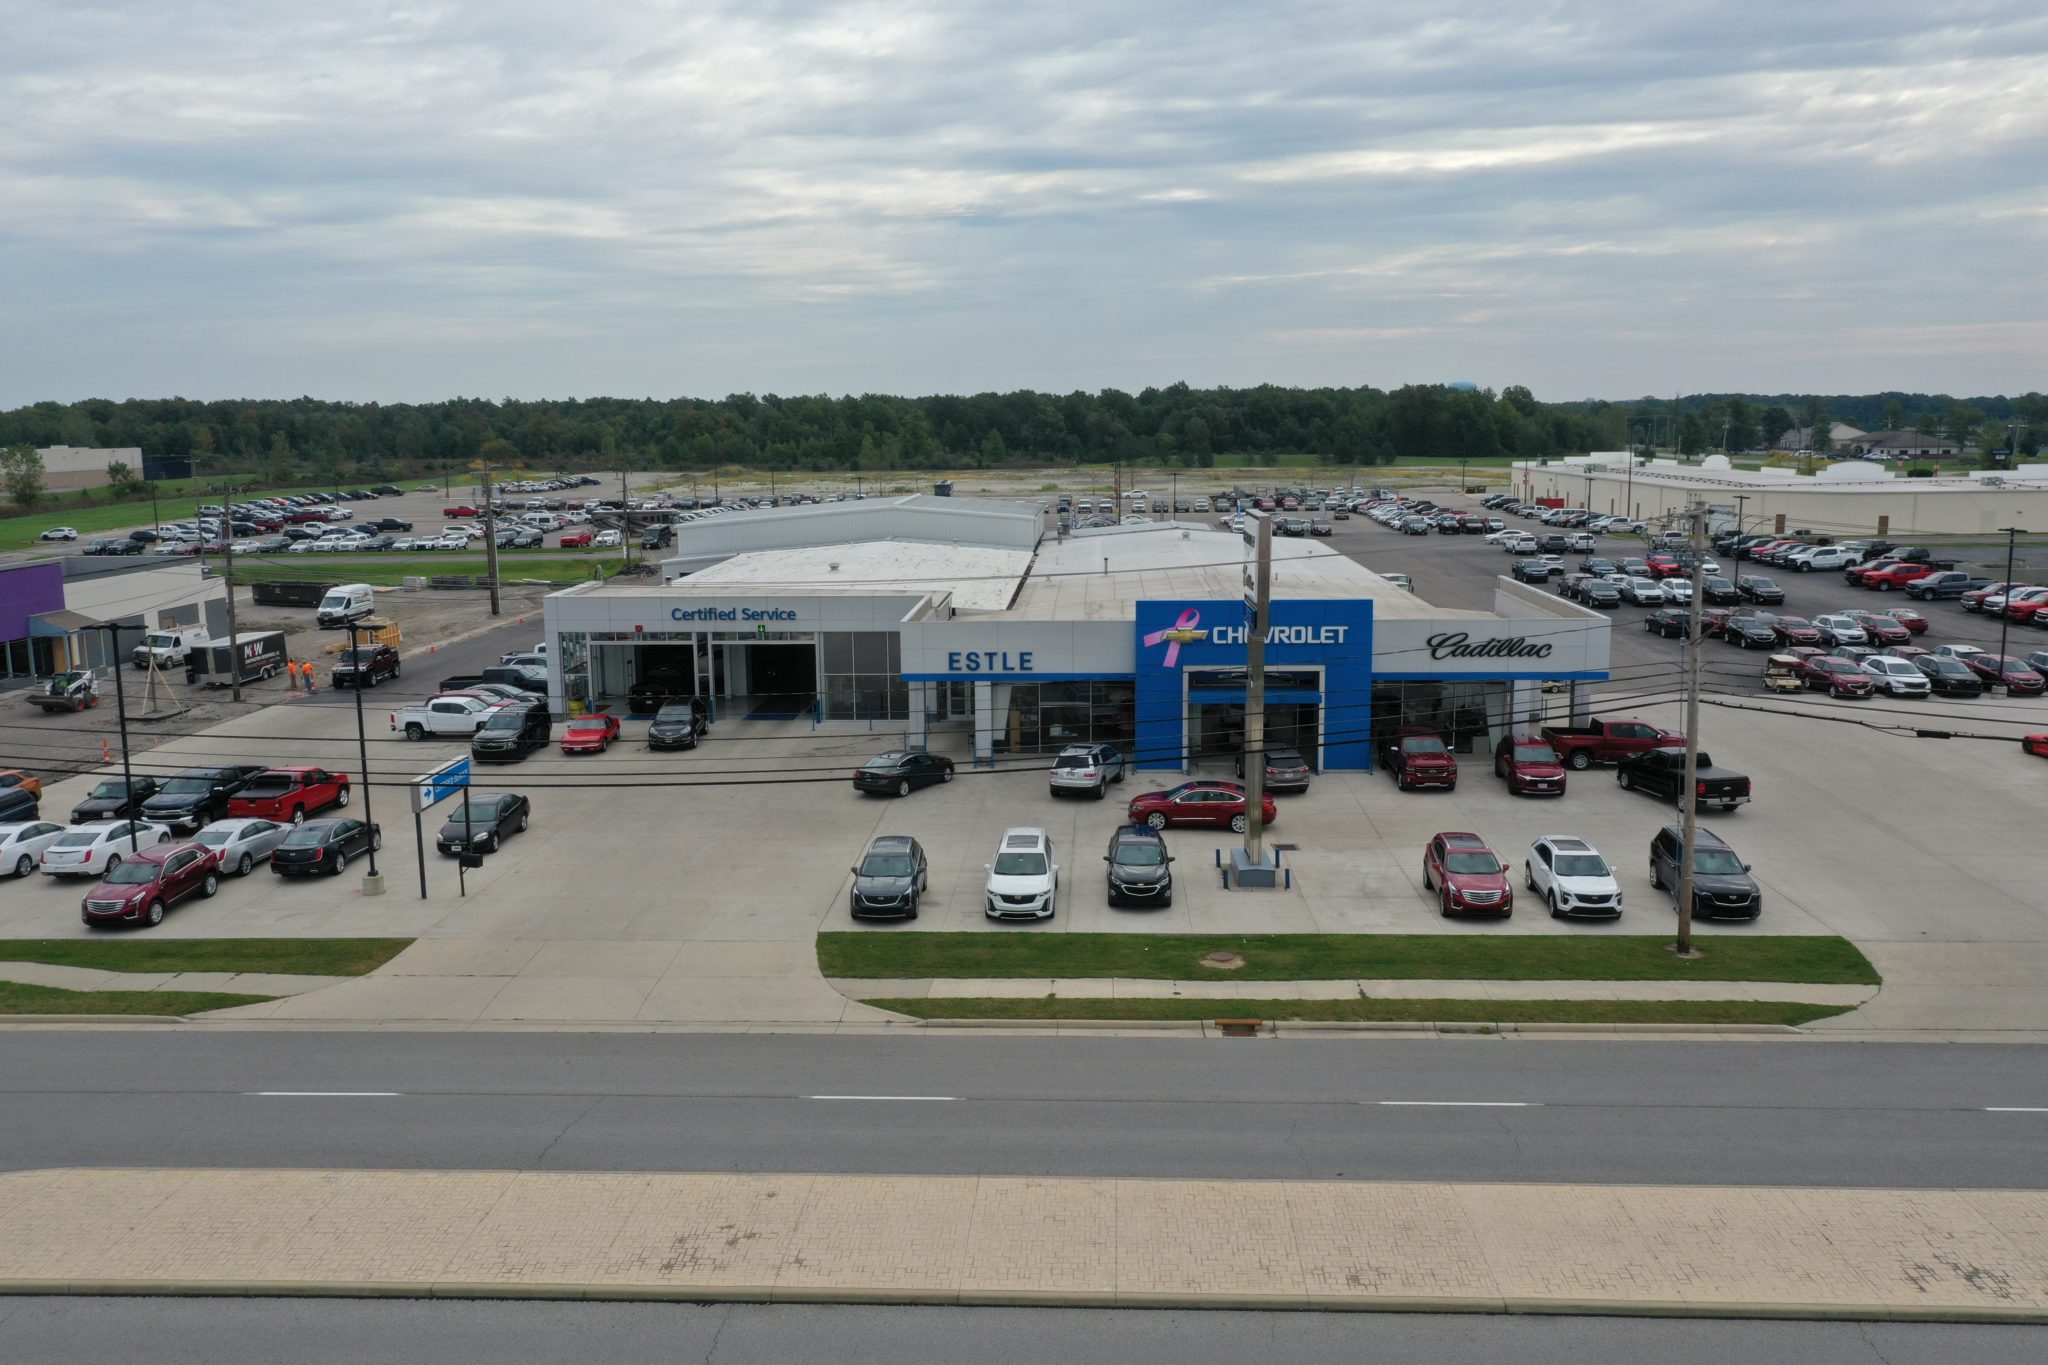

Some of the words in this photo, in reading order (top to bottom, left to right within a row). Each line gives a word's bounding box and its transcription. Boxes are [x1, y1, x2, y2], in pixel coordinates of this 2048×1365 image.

[671, 607, 737, 621] Certified
[742, 607, 796, 621] Service
[1212, 625, 1349, 645] CHVROLET
[1426, 631, 1553, 661] Cadillac
[948, 651, 1033, 672] ESTLE
